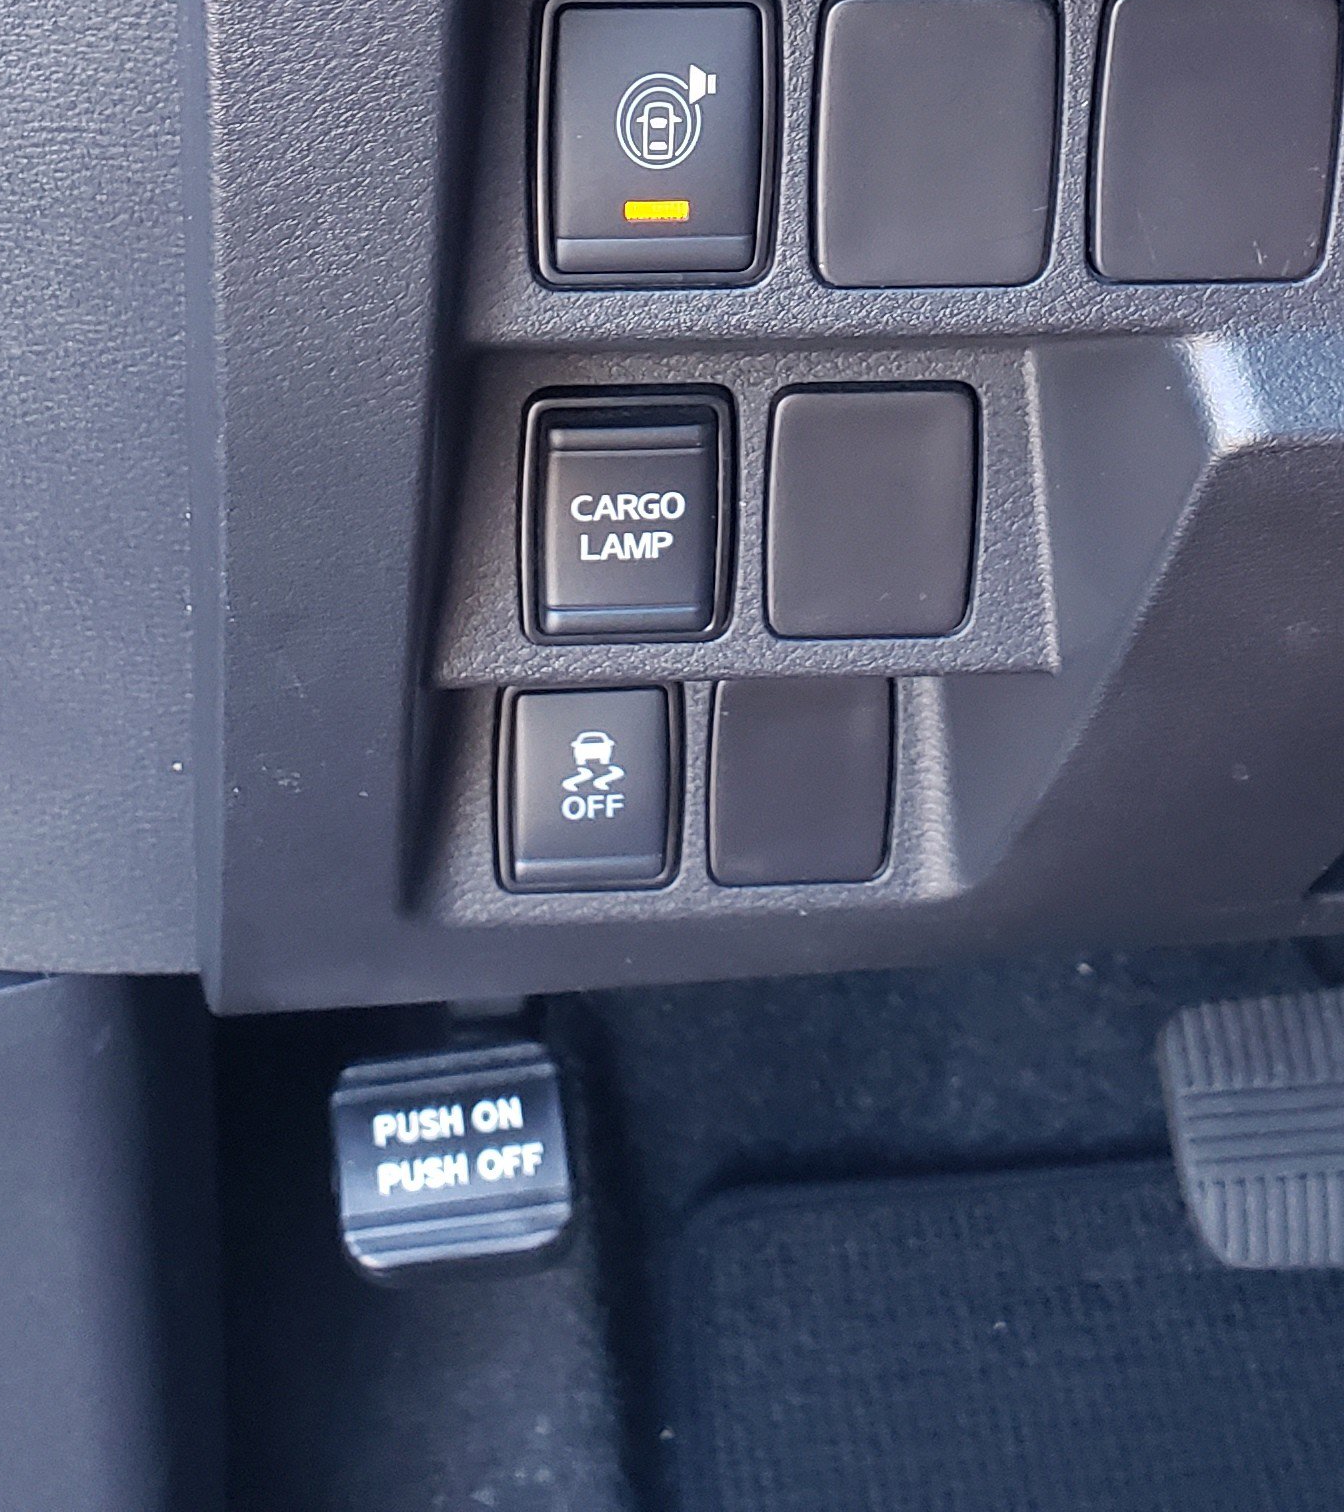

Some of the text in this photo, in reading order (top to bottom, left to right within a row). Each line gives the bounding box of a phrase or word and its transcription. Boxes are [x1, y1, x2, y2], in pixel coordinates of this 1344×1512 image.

[570, 491, 686, 522] CARGO
[580, 531, 674, 561] LAMP
[561, 794, 625, 820] OFF
[372, 1095, 523, 1148] PUSH ON
[376, 1141, 544, 1196] PUSH OFF
